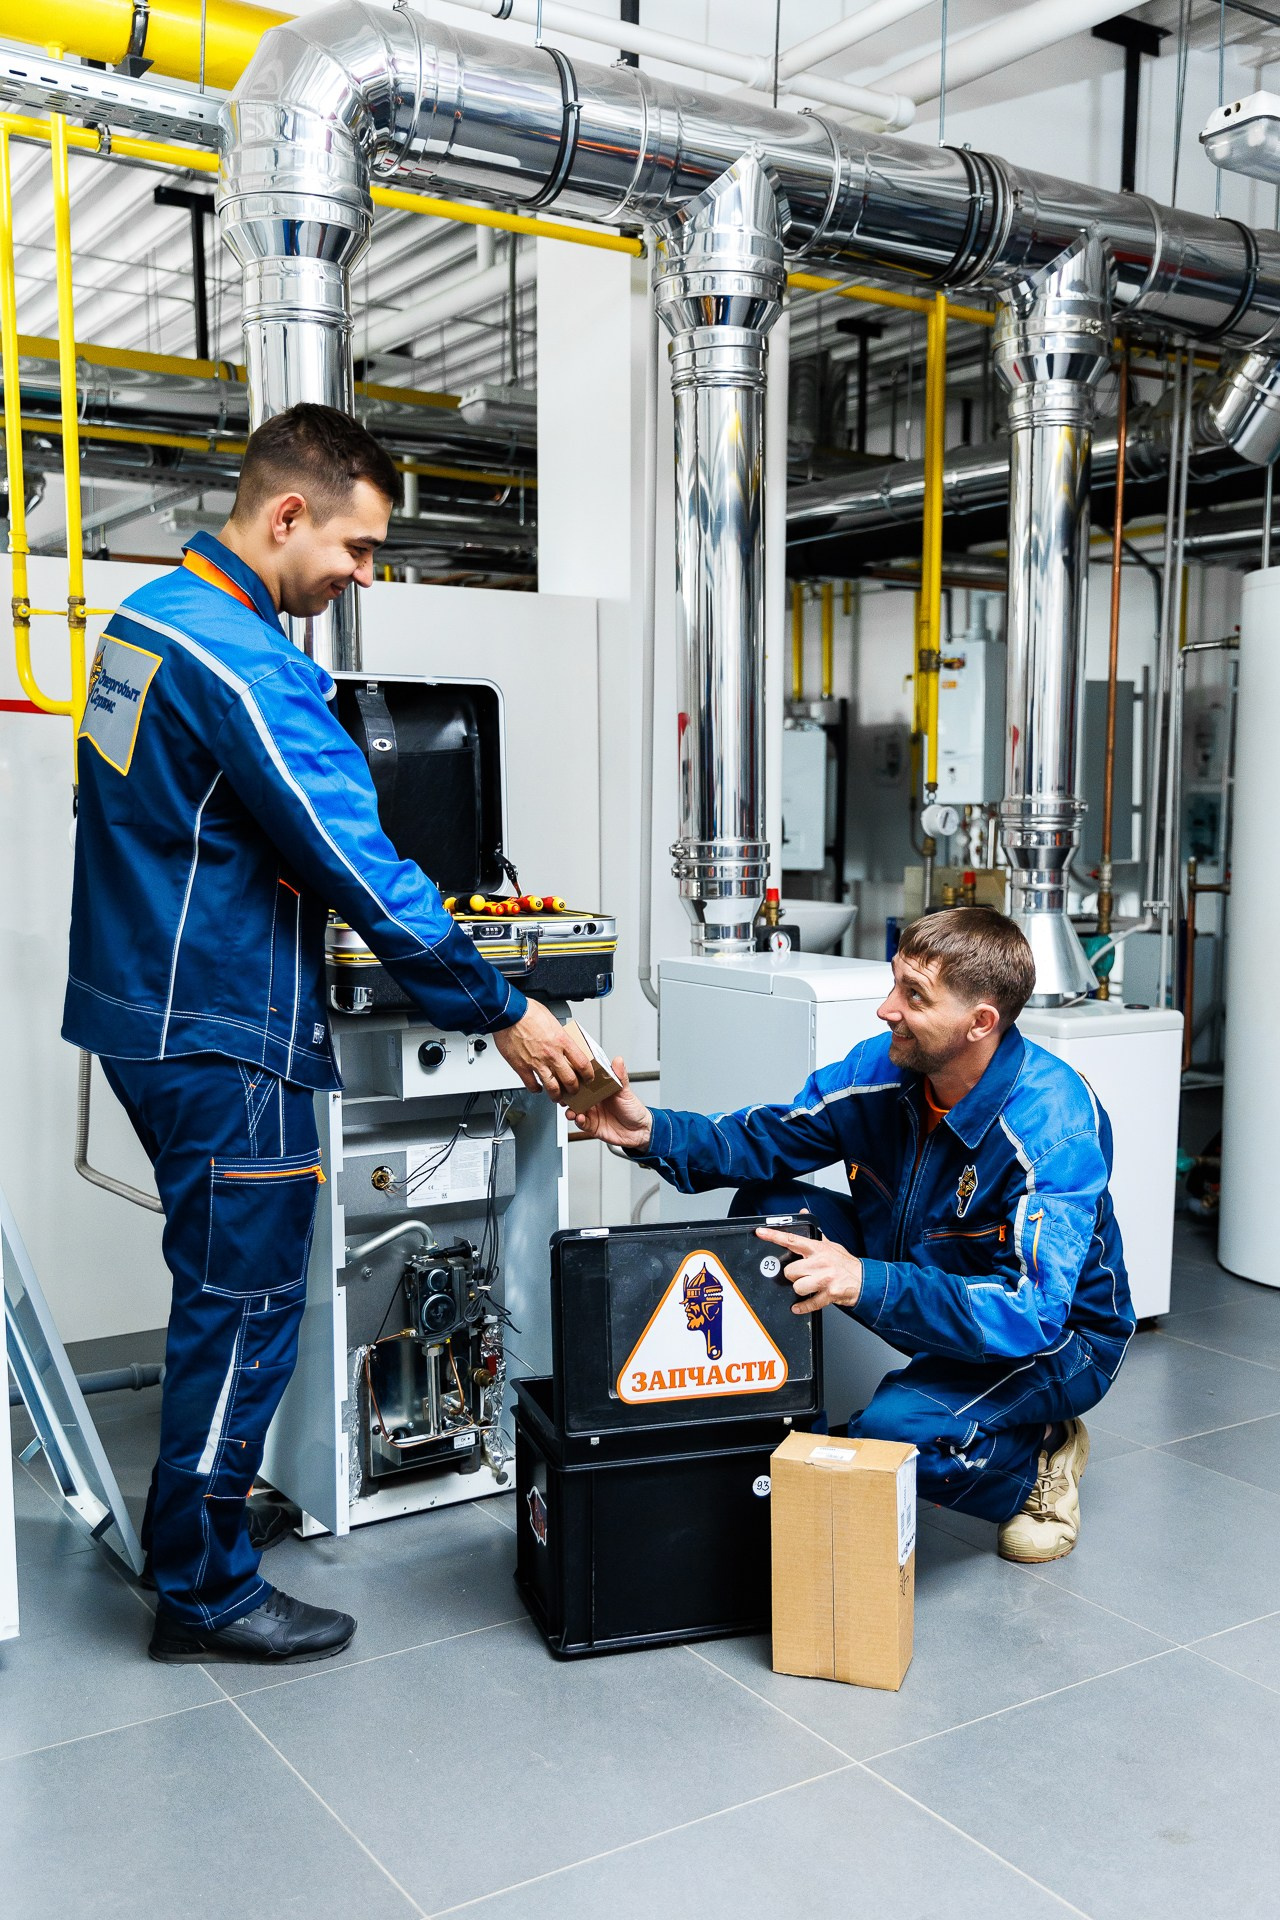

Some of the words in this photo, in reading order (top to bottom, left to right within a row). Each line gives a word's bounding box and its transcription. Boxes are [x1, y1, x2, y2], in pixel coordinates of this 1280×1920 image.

[98, 668, 141, 702] Энергобыт
[90, 688, 116, 713] Сервис
[763, 1260, 776, 1271] 93
[631, 1360, 776, 1392] ЗАПЧАСТИ
[756, 1480, 770, 1491] 93
